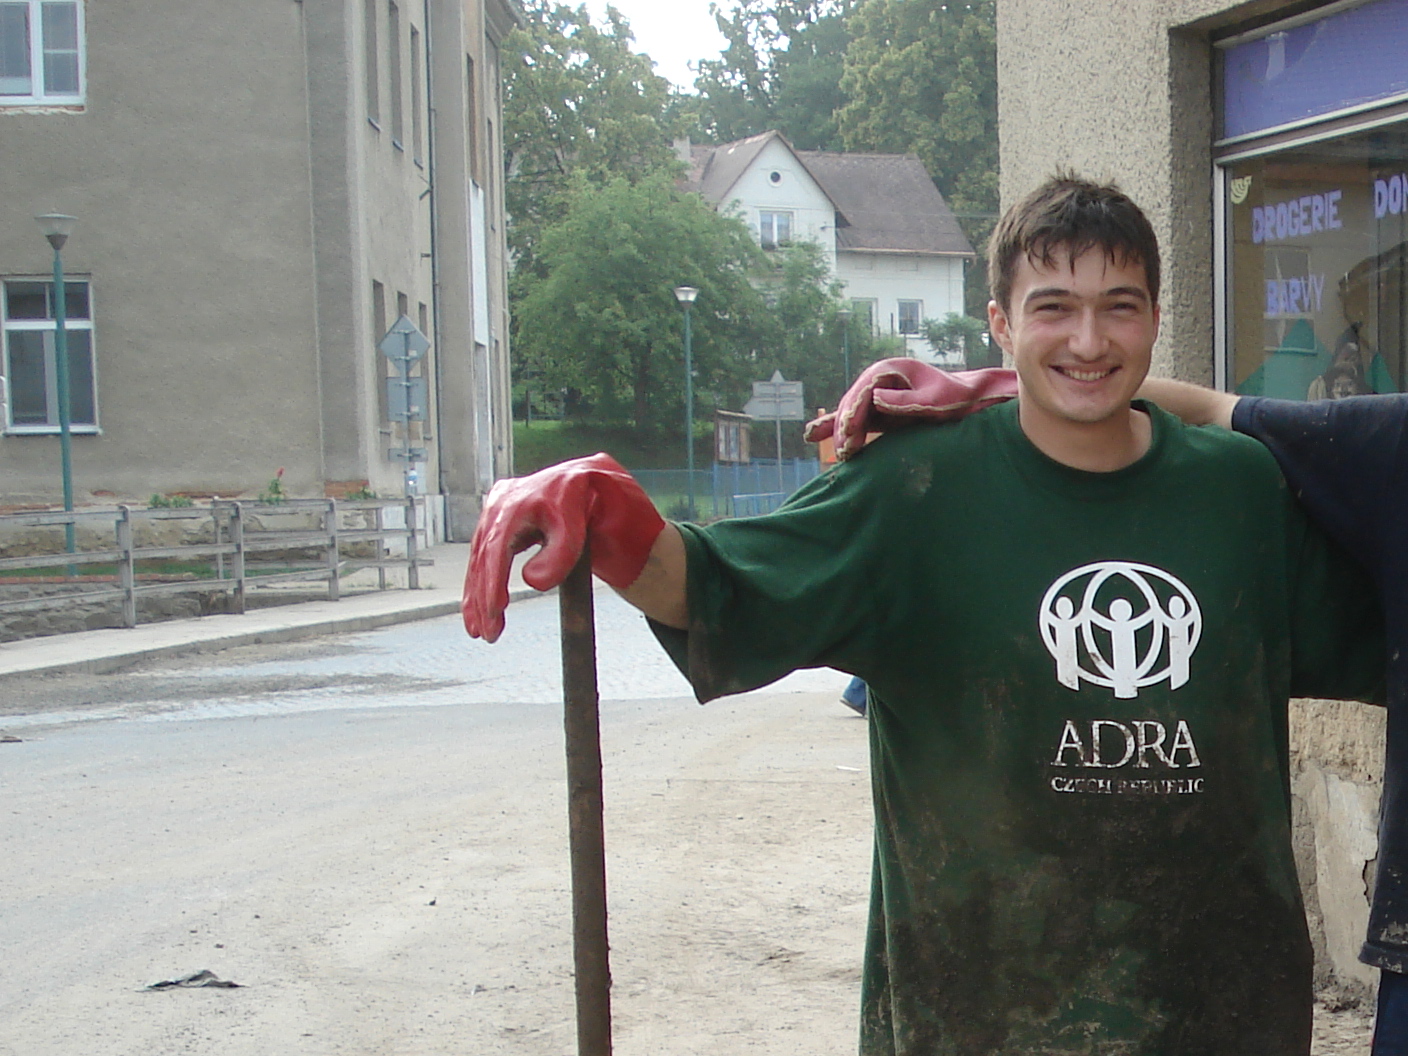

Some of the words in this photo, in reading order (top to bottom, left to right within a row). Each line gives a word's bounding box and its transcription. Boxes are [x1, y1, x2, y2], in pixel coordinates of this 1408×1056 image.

[1252, 190, 1342, 244] DROGERIE
[1266, 273, 1325, 315] BARVY
[1050, 719, 1201, 769] ADRA
